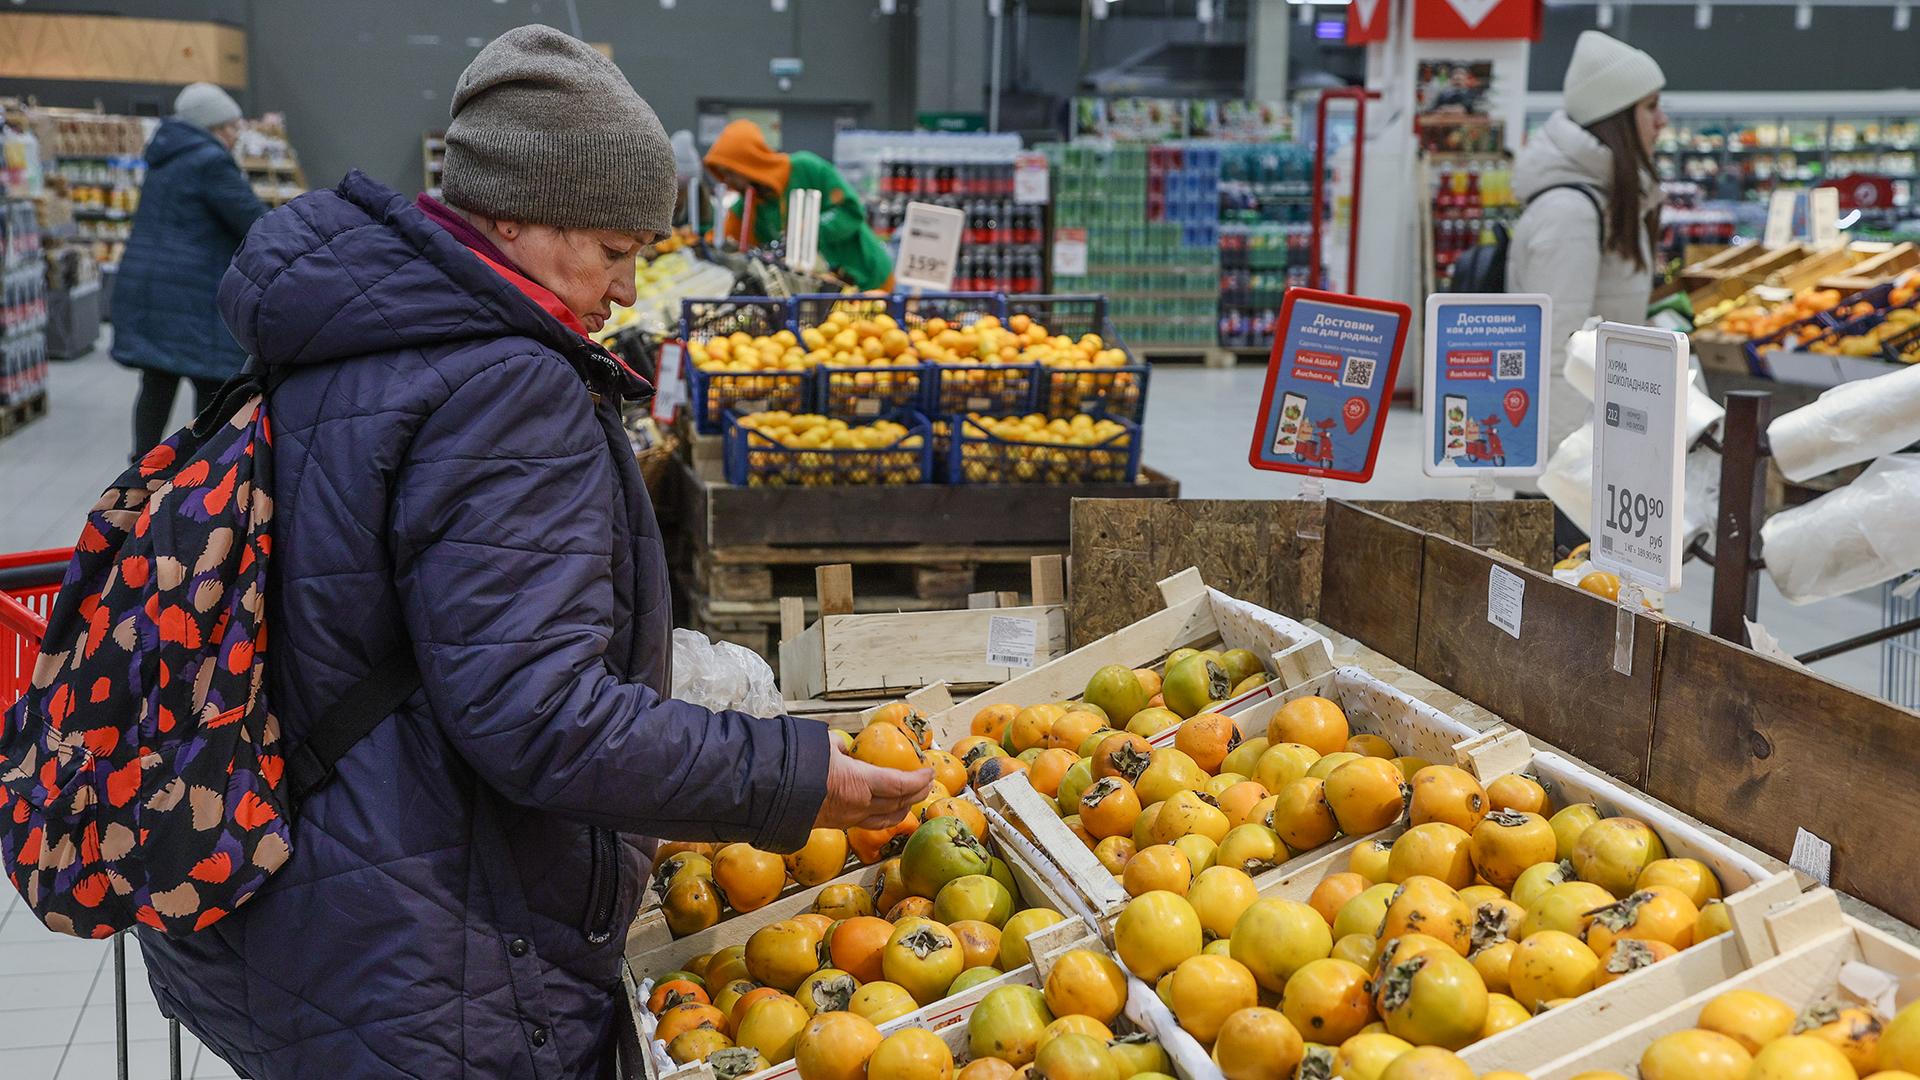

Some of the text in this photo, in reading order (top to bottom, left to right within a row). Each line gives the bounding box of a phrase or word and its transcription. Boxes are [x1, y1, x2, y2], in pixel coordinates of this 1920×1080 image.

[1313, 313, 1374, 332] Доставим
[1457, 313, 1516, 326] Доставим
[1301, 326, 1383, 344] как для родных!
[1465, 327, 1484, 335] для
[1486, 324, 1526, 336] родных!
[1313, 358, 1338, 367] АШАН
[1608, 360, 1628, 373] ХУРМА
[1295, 369, 1333, 380] Auchan.ru
[1607, 373, 1662, 395] ШОКОЛАДНАЯ ВЕС
[1607, 408, 1618, 421] 212
[1650, 535, 1663, 549] руб
